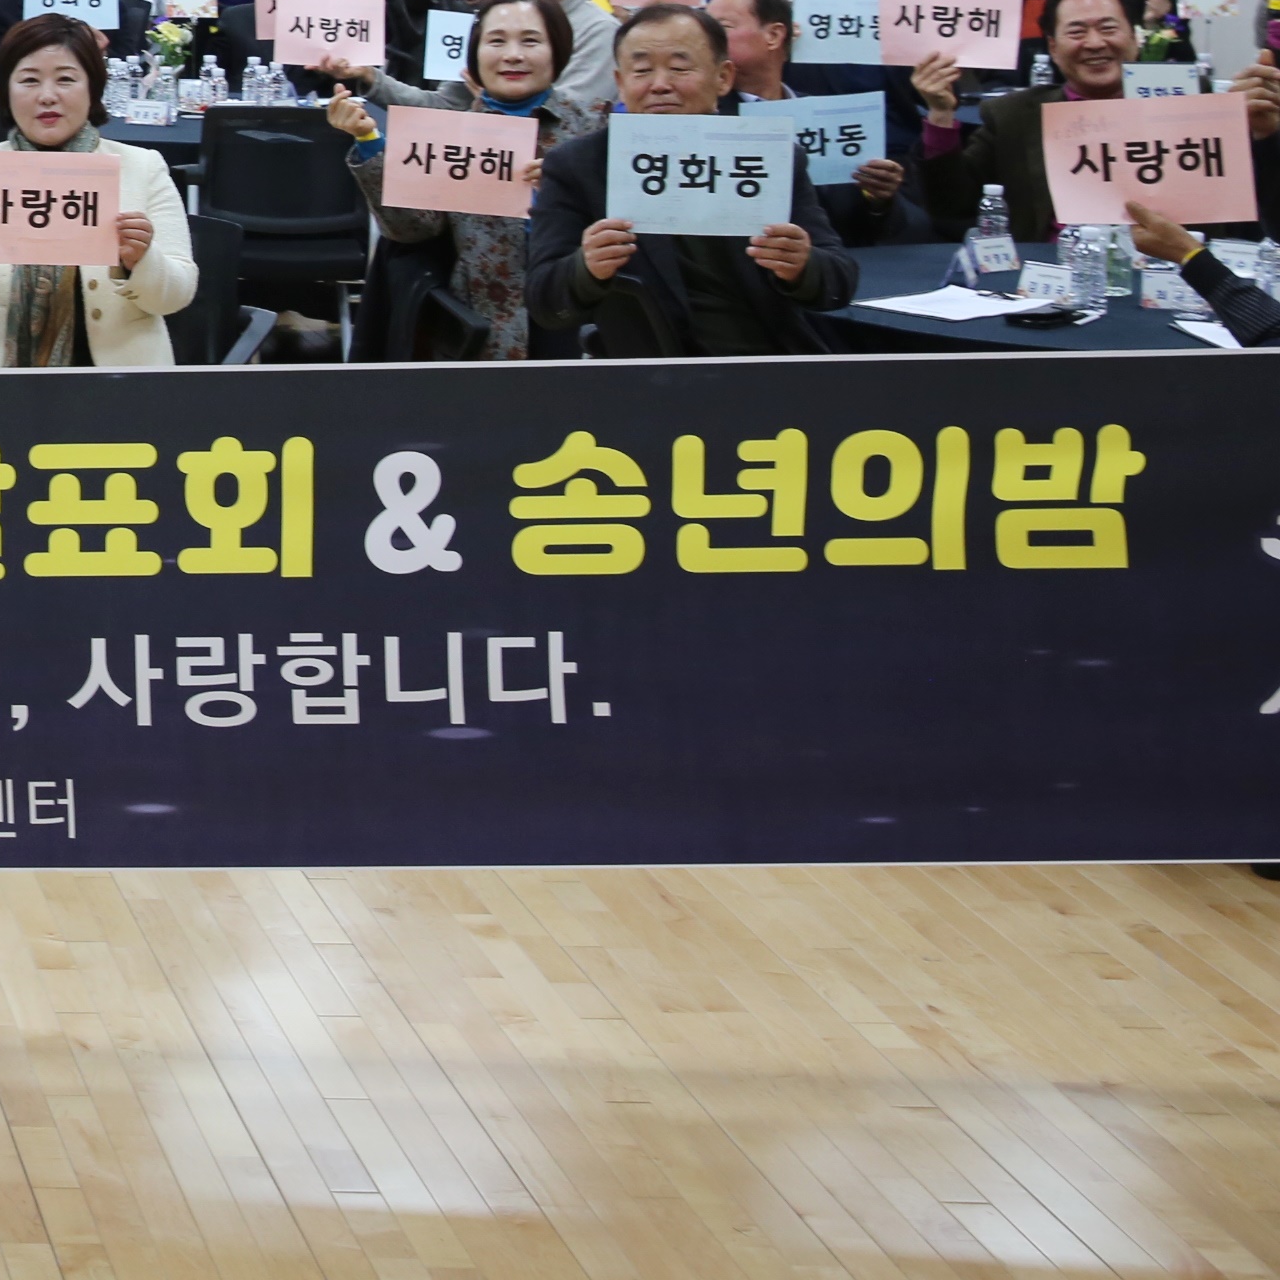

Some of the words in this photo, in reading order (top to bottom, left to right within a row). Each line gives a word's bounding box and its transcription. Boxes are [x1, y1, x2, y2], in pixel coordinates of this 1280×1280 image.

[289, 17, 369, 42] 사랑해
[894, 5, 1000, 37] 사랑해
[795, 124, 866, 157] 화동
[1071, 137, 1224, 184] 사랑해
[403, 143, 513, 181] 사랑해
[632, 154, 768, 197] 영화동
[365, 451, 462, 574] &
[509, 424, 1146, 575] 송년의밤
[67, 632, 611, 727] 사랑합니다.
